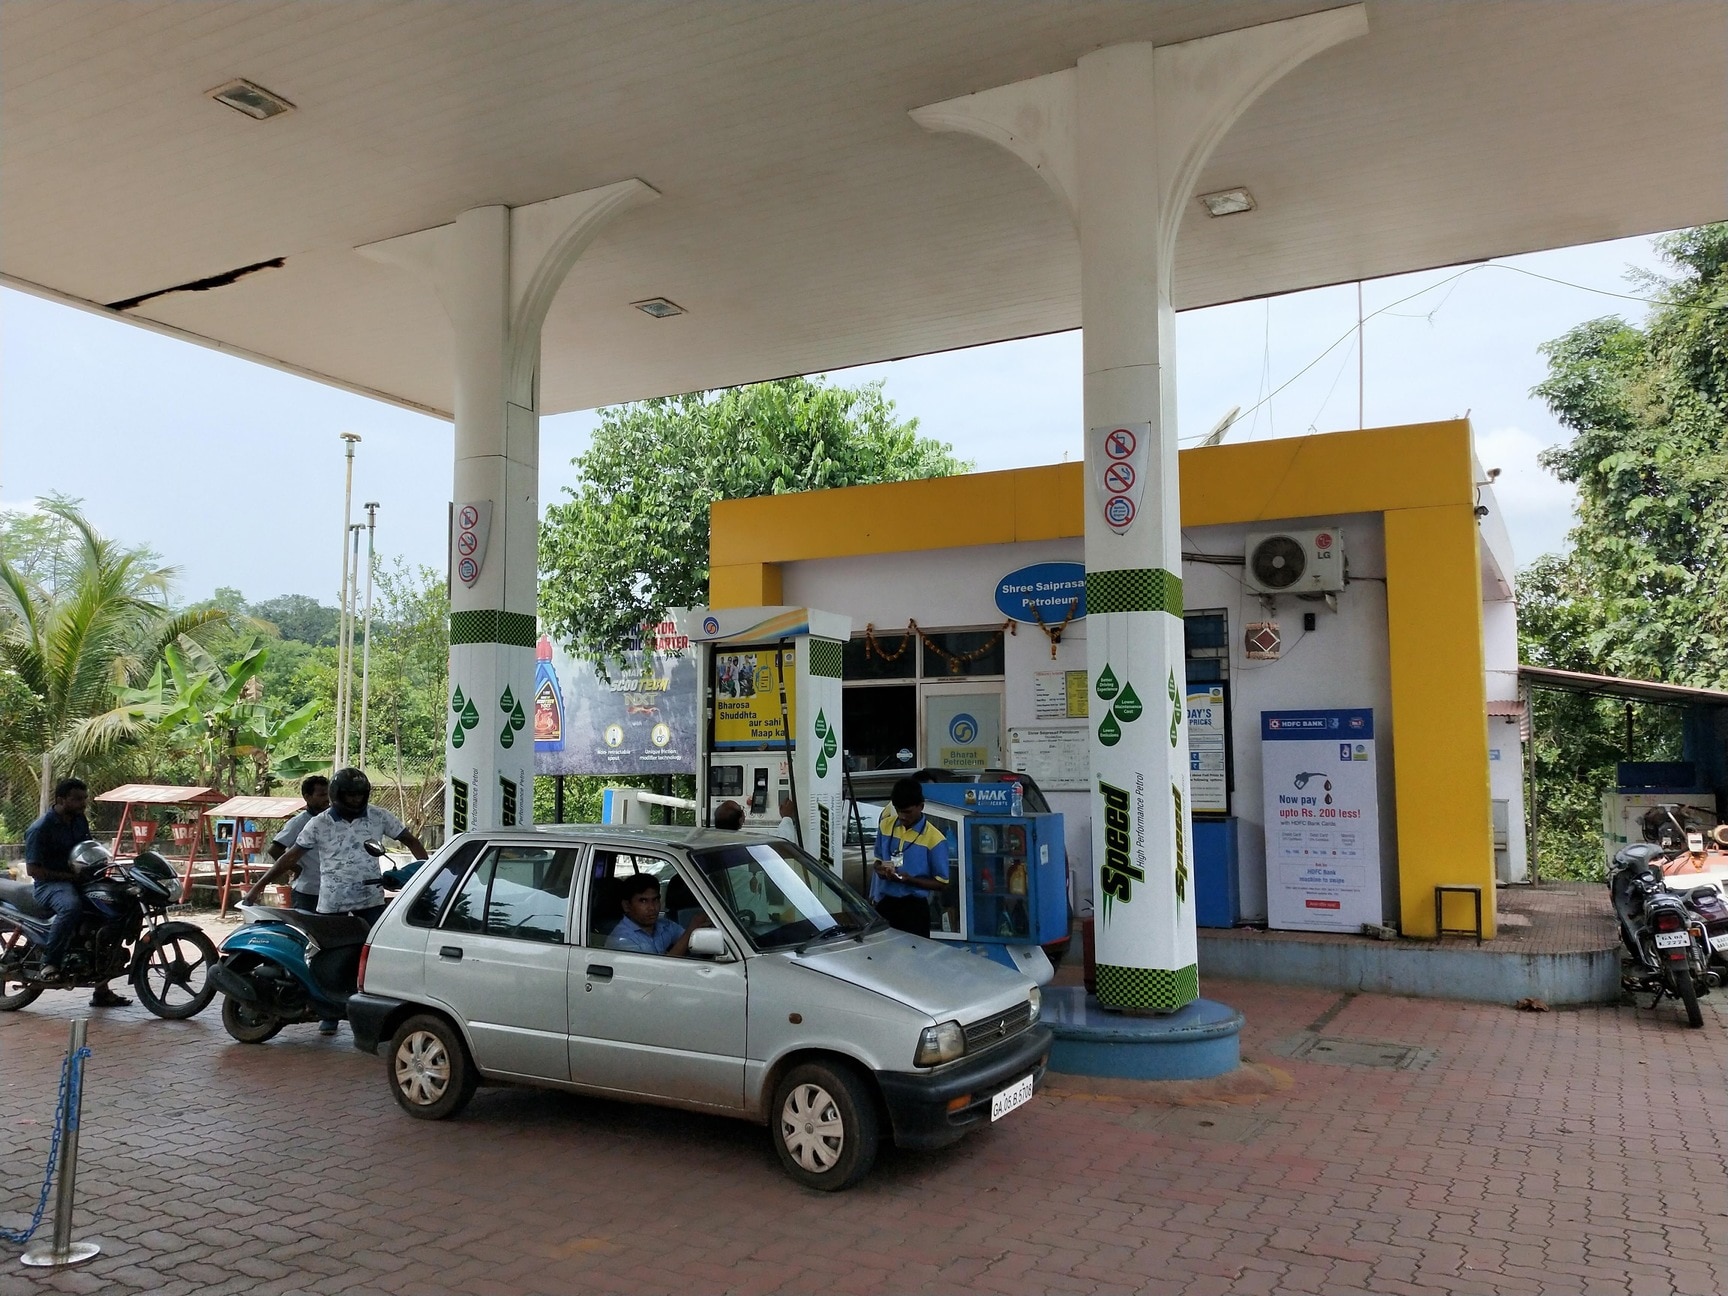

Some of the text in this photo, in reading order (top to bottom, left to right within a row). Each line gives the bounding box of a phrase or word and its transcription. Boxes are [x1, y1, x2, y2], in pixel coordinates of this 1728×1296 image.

[1002, 580, 1086, 594] Shree Saiprasa
[623, 692, 659, 706] NXT
[717, 701, 750, 710] Bharosa
[720, 711, 757, 720] Shuddhta
[749, 718, 782, 727] aur sahi
[751, 729, 773, 738] Maap
[950, 751, 977, 759] Bharat
[943, 758, 985, 766] Petroleum
[978, 790, 1007, 800] MAK
[1279, 794, 1317, 806] Now pay
[213, 799, 298, 814] FIRE
[470, 787, 479, 827] Performance
[1279, 808, 1361, 819] upto Rs. 200 less!
[1134, 772, 1147, 869] High Performance Petrol
[1099, 780, 1145, 904] Speed
[993, 1101, 1003, 1117] GA
